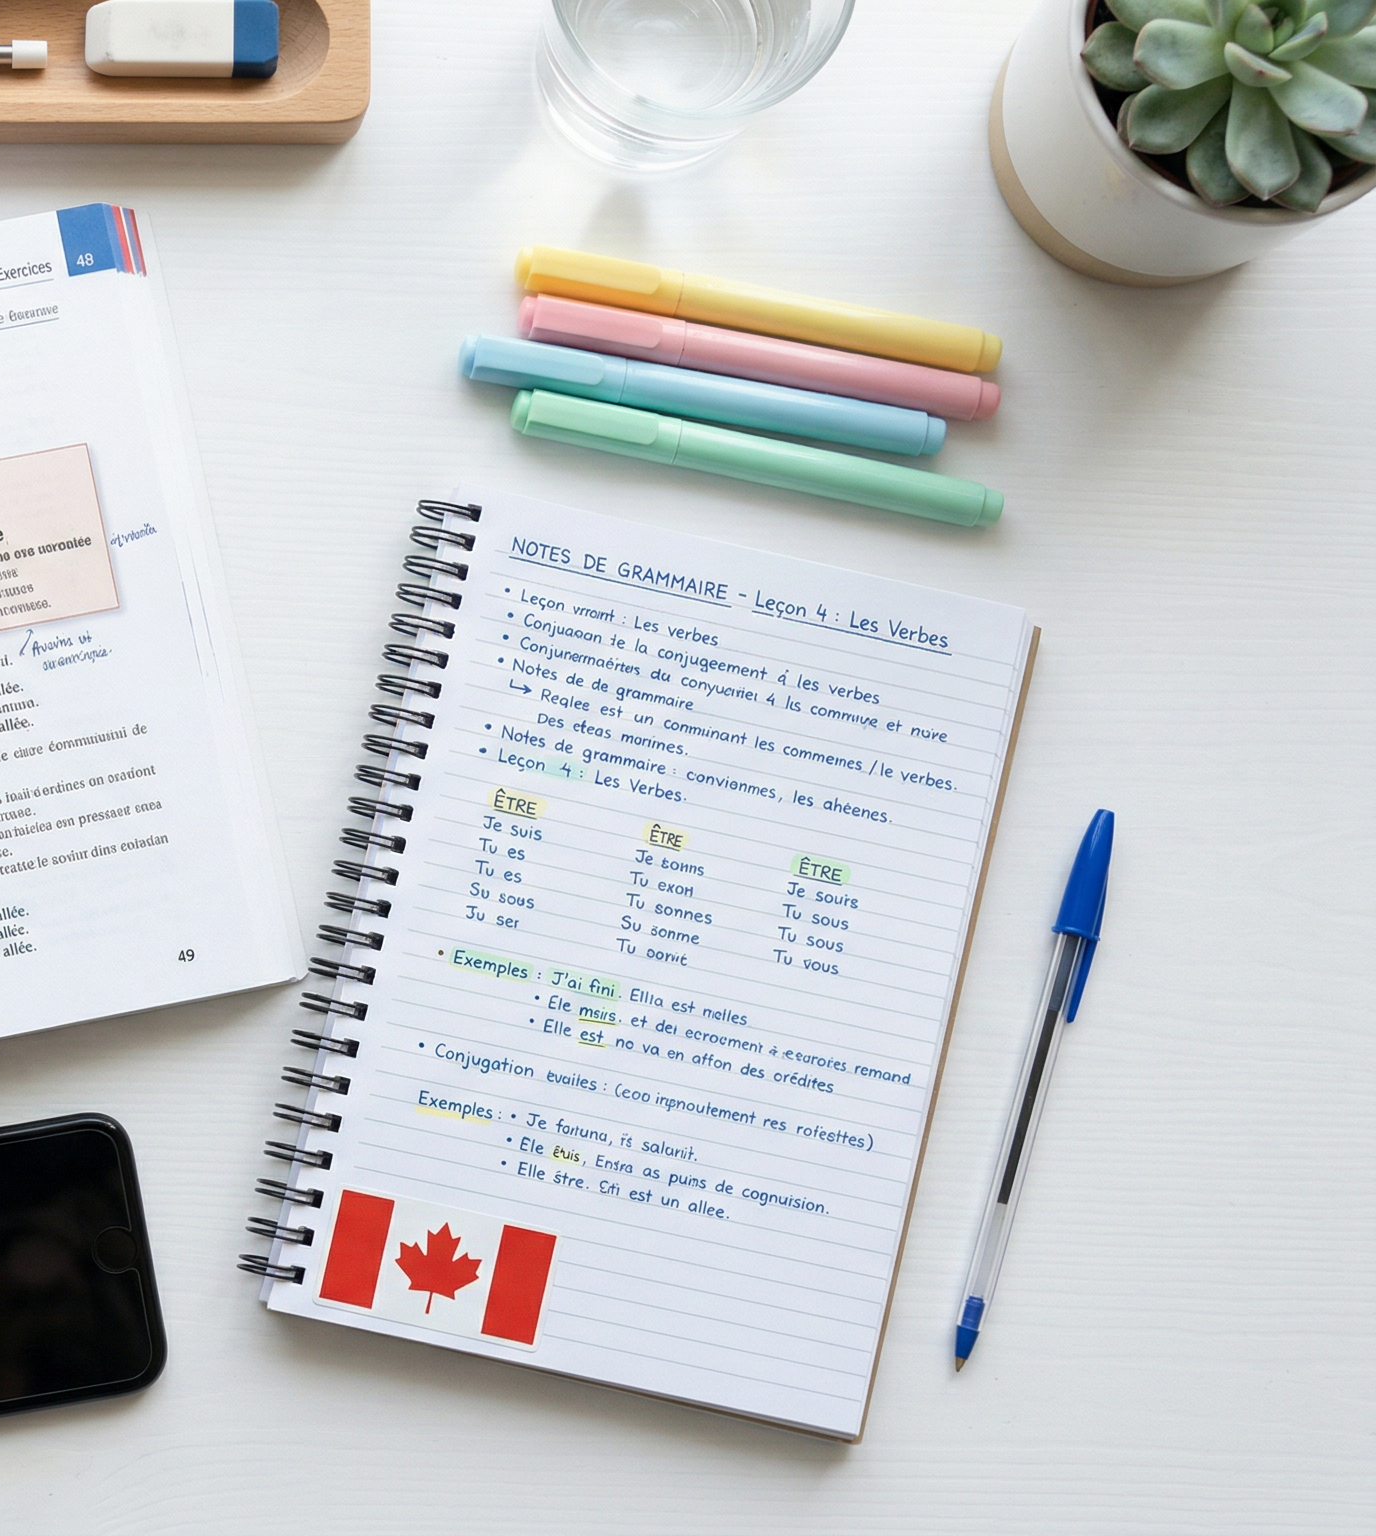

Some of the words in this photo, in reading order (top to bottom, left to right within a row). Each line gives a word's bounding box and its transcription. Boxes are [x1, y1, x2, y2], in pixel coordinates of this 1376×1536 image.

[75, 253, 94, 268] 48
[511, 535, 571, 565] NOTES
[582, 552, 608, 573] DE
[617, 561, 729, 600] GRAMMAIRE
[754, 589, 807, 620] Leçon
[815, 603, 827, 623] 4
[848, 609, 879, 633] Les
[888, 618, 949, 649] Verbes
[520, 588, 565, 611] Leçon
[633, 614, 659, 633] Les
[667, 625, 719, 647] verbes
[511, 657, 558, 681] Notes
[565, 672, 585, 688] de
[590, 677, 609, 693] de
[615, 686, 694, 711] grammaire
[633, 637, 648, 655] la
[656, 647, 768, 681] conjugeement
[796, 673, 820, 692] les
[828, 683, 880, 705] verbes
[536, 712, 565, 729] Des
[599, 705, 624, 718] est
[753, 735, 775, 752] les
[899, 770, 957, 791] verbes.
[497, 747, 546, 773] Leçon
[558, 761, 572, 778] 4
[593, 769, 620, 789] Les
[628, 777, 687, 803] Verbes.
[499, 724, 546, 750] Notes
[553, 738, 574, 755] de
[581, 747, 666, 775] grammaire
[792, 789, 814, 808] les
[493, 787, 538, 819] ÊTRE
[482, 814, 503, 833] Je
[509, 824, 543, 842] suis
[648, 822, 684, 848] ÊTRE
[478, 836, 498, 855] Tu
[634, 848, 654, 866] Je
[474, 858, 495, 877] Tu
[629, 870, 649, 888] Tu
[794, 855, 843, 886] ÊTRE
[497, 892, 535, 910] sous
[786, 880, 806, 899] Je
[625, 892, 645, 910] Tu
[653, 902, 713, 925] sonnes
[781, 902, 802, 921] Tu
[810, 912, 849, 931] sous
[2, 940, 37, 958] allée.
[615, 937, 637, 955] Tu
[777, 925, 797, 943] Tu
[805, 934, 844, 953] sous
[177, 947, 195, 963] 49
[772, 948, 793, 966] Tu
[802, 958, 840, 976] vous
[452, 948, 528, 979] Exemples
[550, 970, 587, 995] J'ai
[670, 1000, 696, 1014] est
[547, 994, 572, 1013] Ele
[434, 1042, 535, 1078] Conjugation
[542, 1017, 572, 1037] Elle
[579, 1029, 605, 1044] est
[739, 1062, 765, 1079] des
[525, 1111, 547, 1130] Je
[518, 1135, 544, 1155] Ele
[714, 1178, 734, 1195] de
[516, 1160, 546, 1181] Elle
[628, 1188, 653, 1203] est
